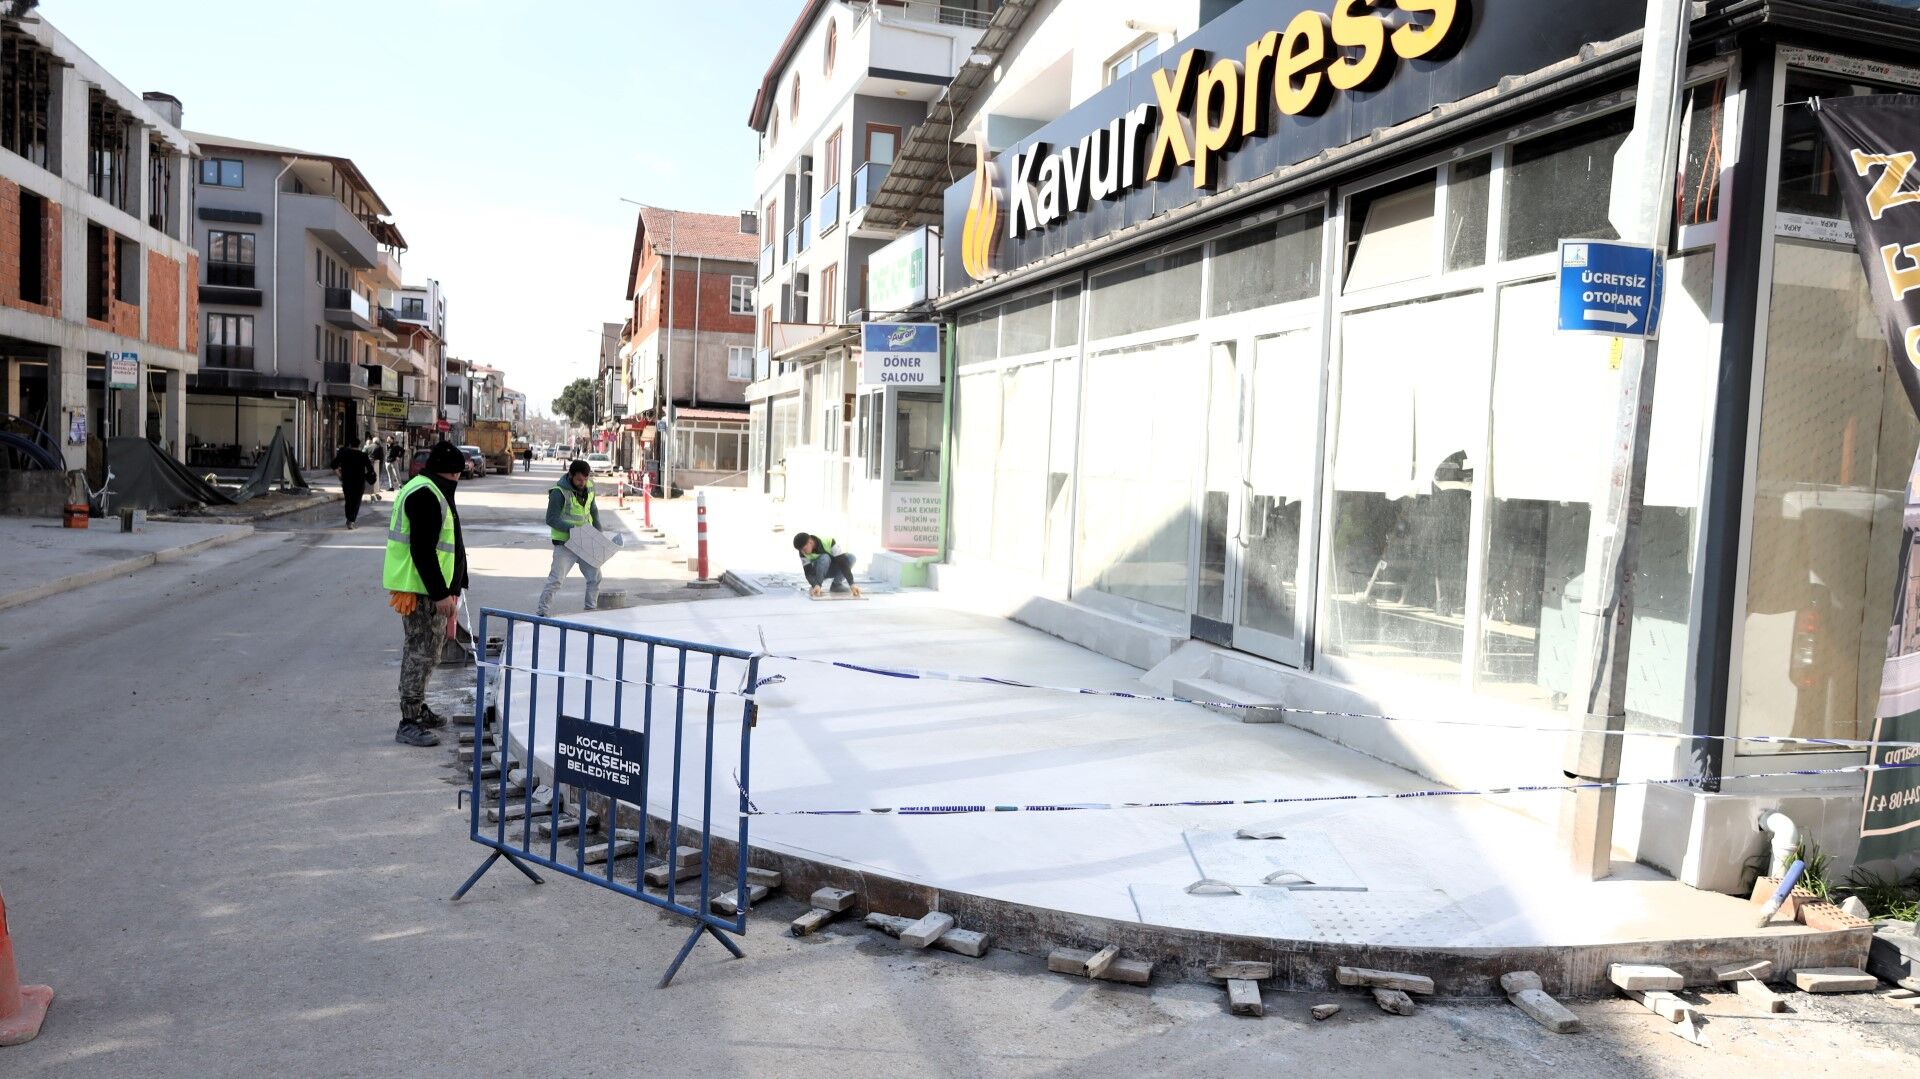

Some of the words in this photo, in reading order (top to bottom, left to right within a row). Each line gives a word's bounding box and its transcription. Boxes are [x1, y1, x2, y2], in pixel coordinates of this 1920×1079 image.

[1783, 223, 1801, 233] AKPA
[1820, 219, 1838, 228] AKPA
[1581, 270, 1646, 288] ÜCRETSİZ
[1582, 291, 1642, 307] OTOPARK
[883, 355, 921, 368] DÖNER
[880, 372, 924, 383] SALONU
[558, 742, 641, 776] BÜYÜKŞEHİR
[567, 759, 630, 786] BELEDİYESİ
